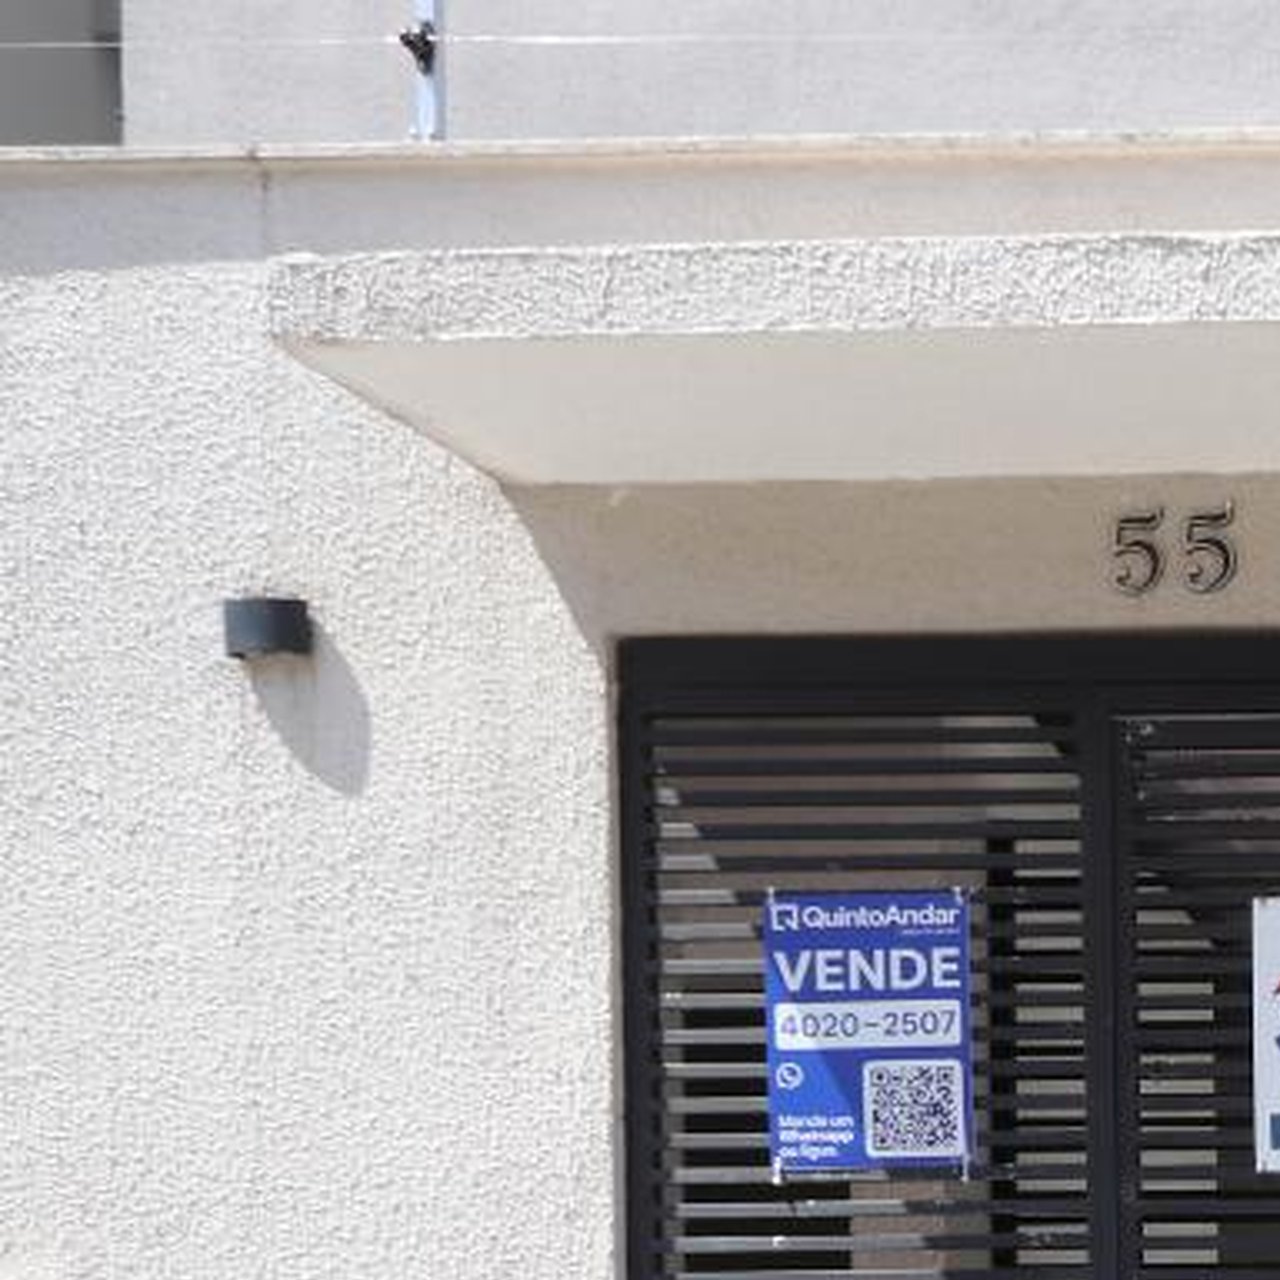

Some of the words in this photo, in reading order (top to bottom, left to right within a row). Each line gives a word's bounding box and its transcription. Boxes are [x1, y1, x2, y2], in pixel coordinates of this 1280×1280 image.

[1112, 500, 1237, 597] 55
[802, 904, 961, 929] QuintoAndar
[773, 946, 961, 991] VENDE
[780, 1009, 957, 1037] 4020-2507
